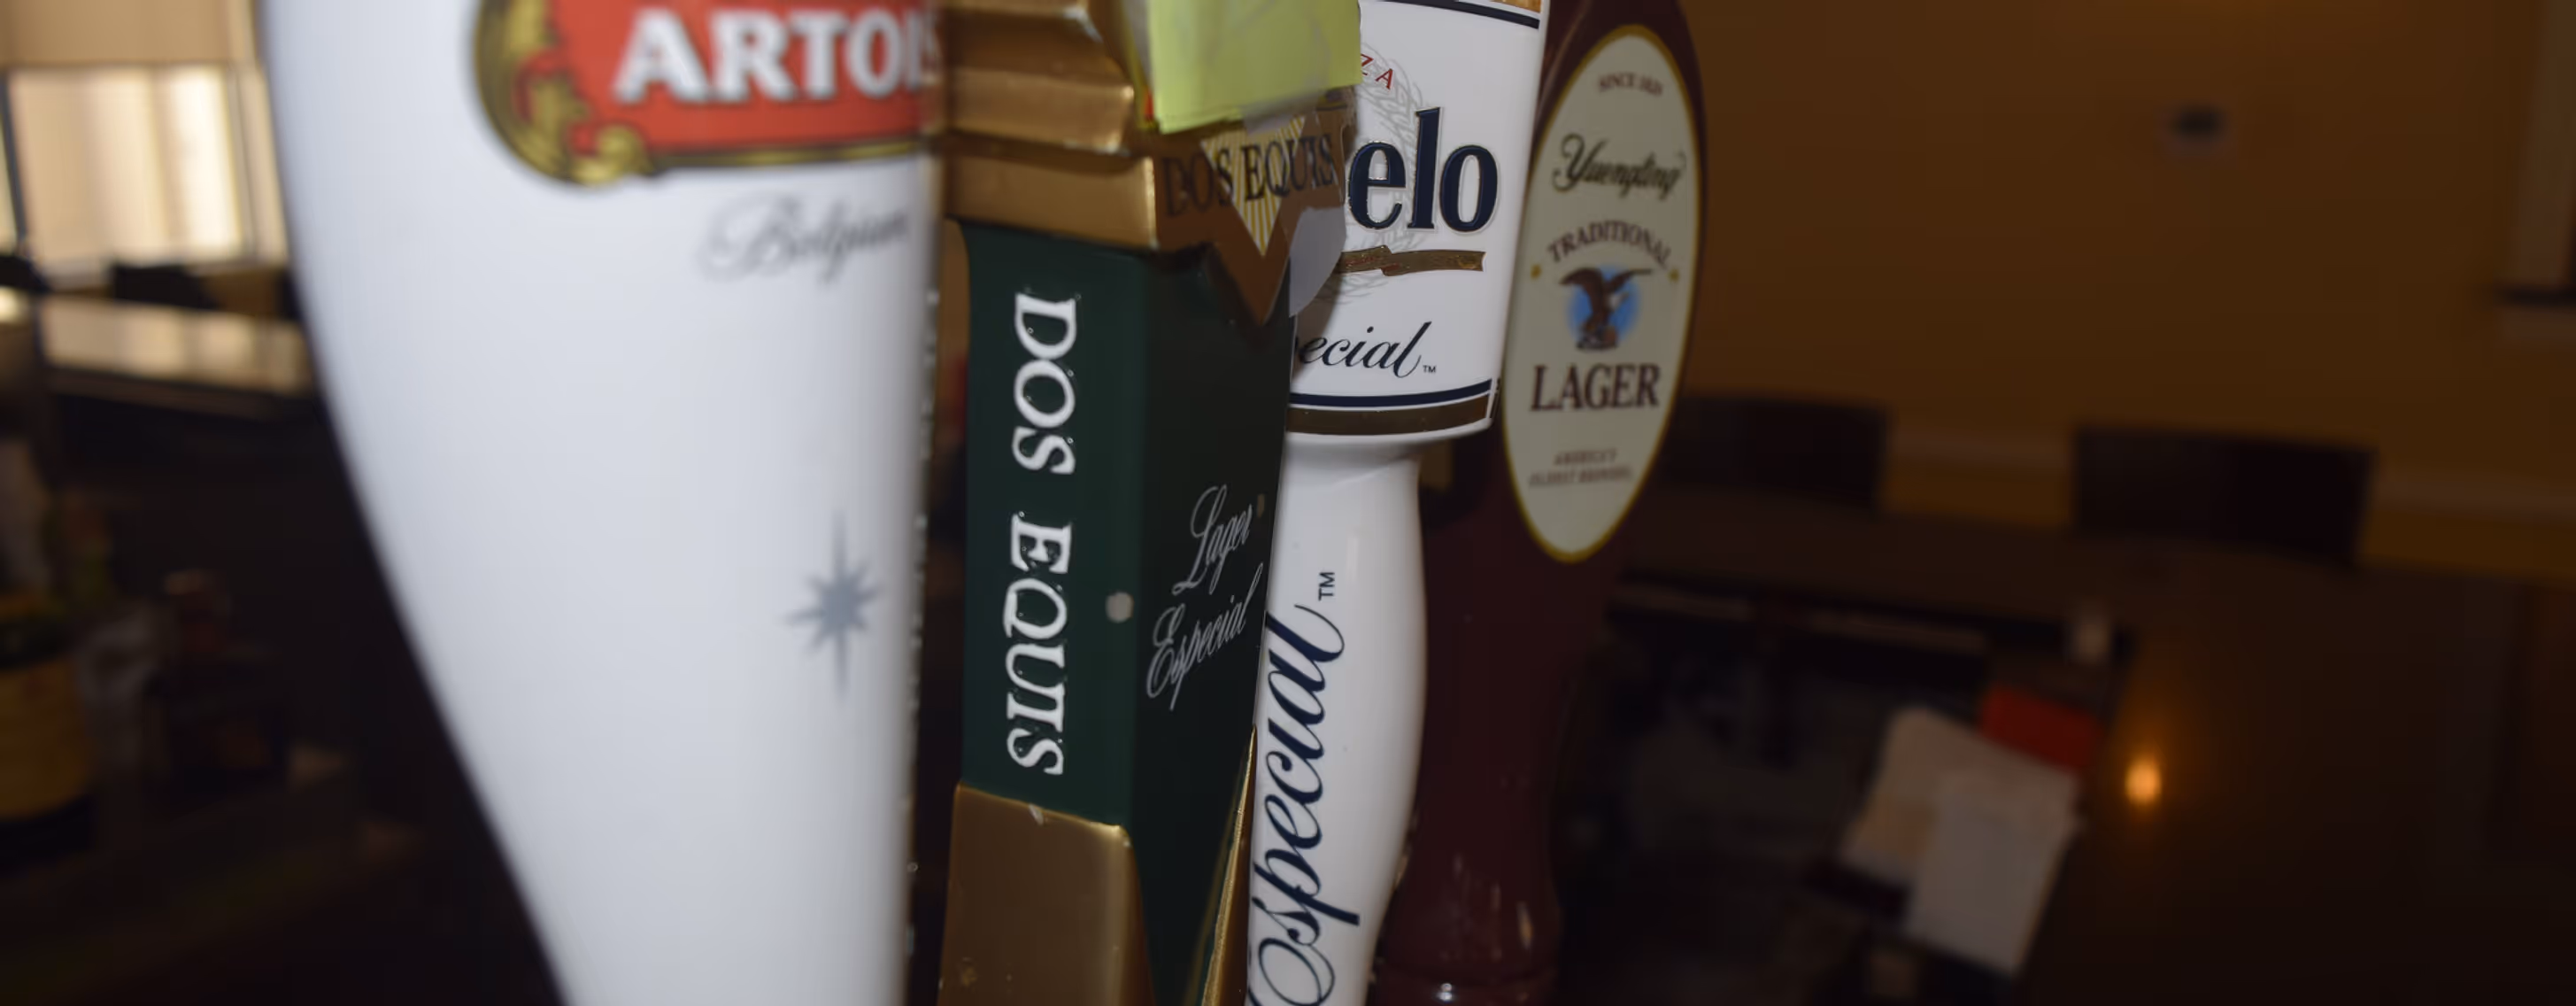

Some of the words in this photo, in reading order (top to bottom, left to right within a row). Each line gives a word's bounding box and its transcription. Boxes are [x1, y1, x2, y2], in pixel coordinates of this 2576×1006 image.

[1161, 147, 1234, 218] DOS
[1241, 133, 1338, 202] EQUIS
[1546, 220, 1672, 269] TRADITIONAL
[1013, 290, 1079, 476] DOS
[1294, 320, 1433, 379] ecial
[1530, 361, 1661, 413] LAGER
[1171, 484, 1253, 597] Lager
[1002, 511, 1074, 776] EQUIS
[1145, 561, 1264, 712] Especial
